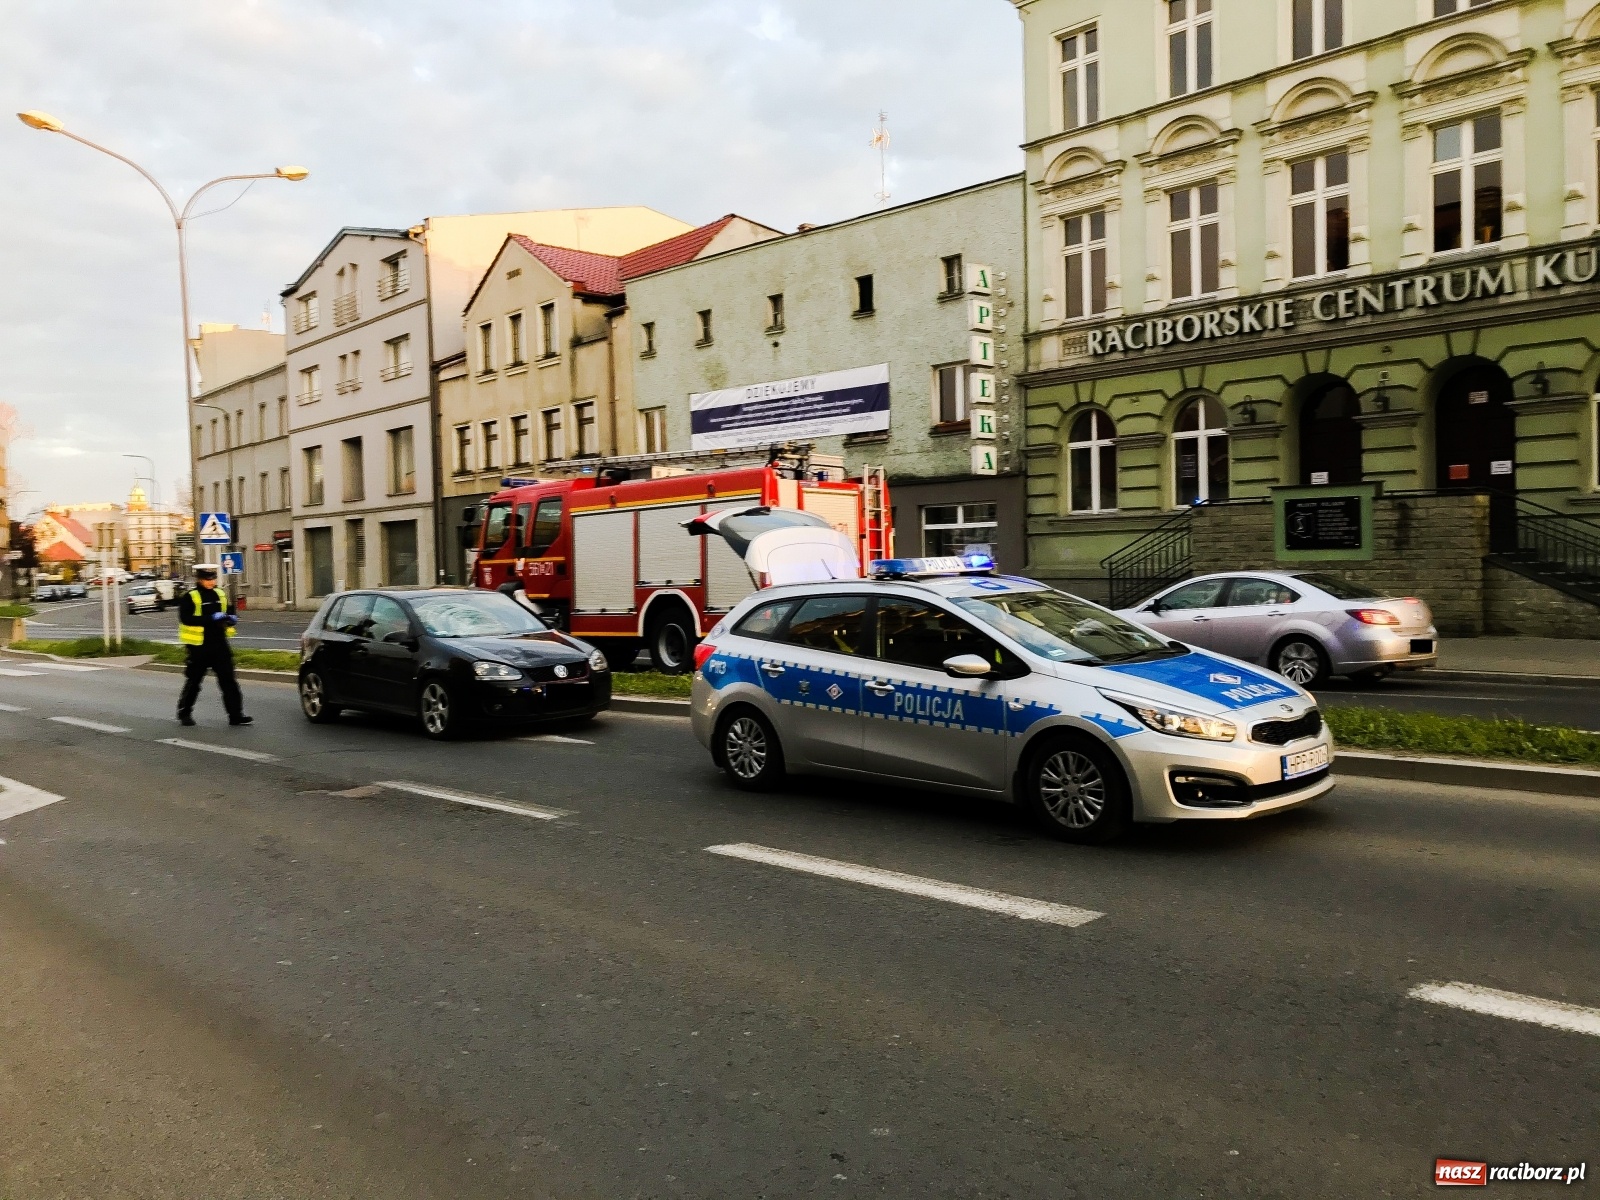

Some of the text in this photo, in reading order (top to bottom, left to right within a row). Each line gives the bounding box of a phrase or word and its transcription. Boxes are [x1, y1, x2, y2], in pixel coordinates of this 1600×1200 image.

[1087, 248, 1597, 355] RACIBORSKIE CENTRUM KU
[976, 269, 995, 470] APTEKA
[894, 692, 964, 720] POLICJA
